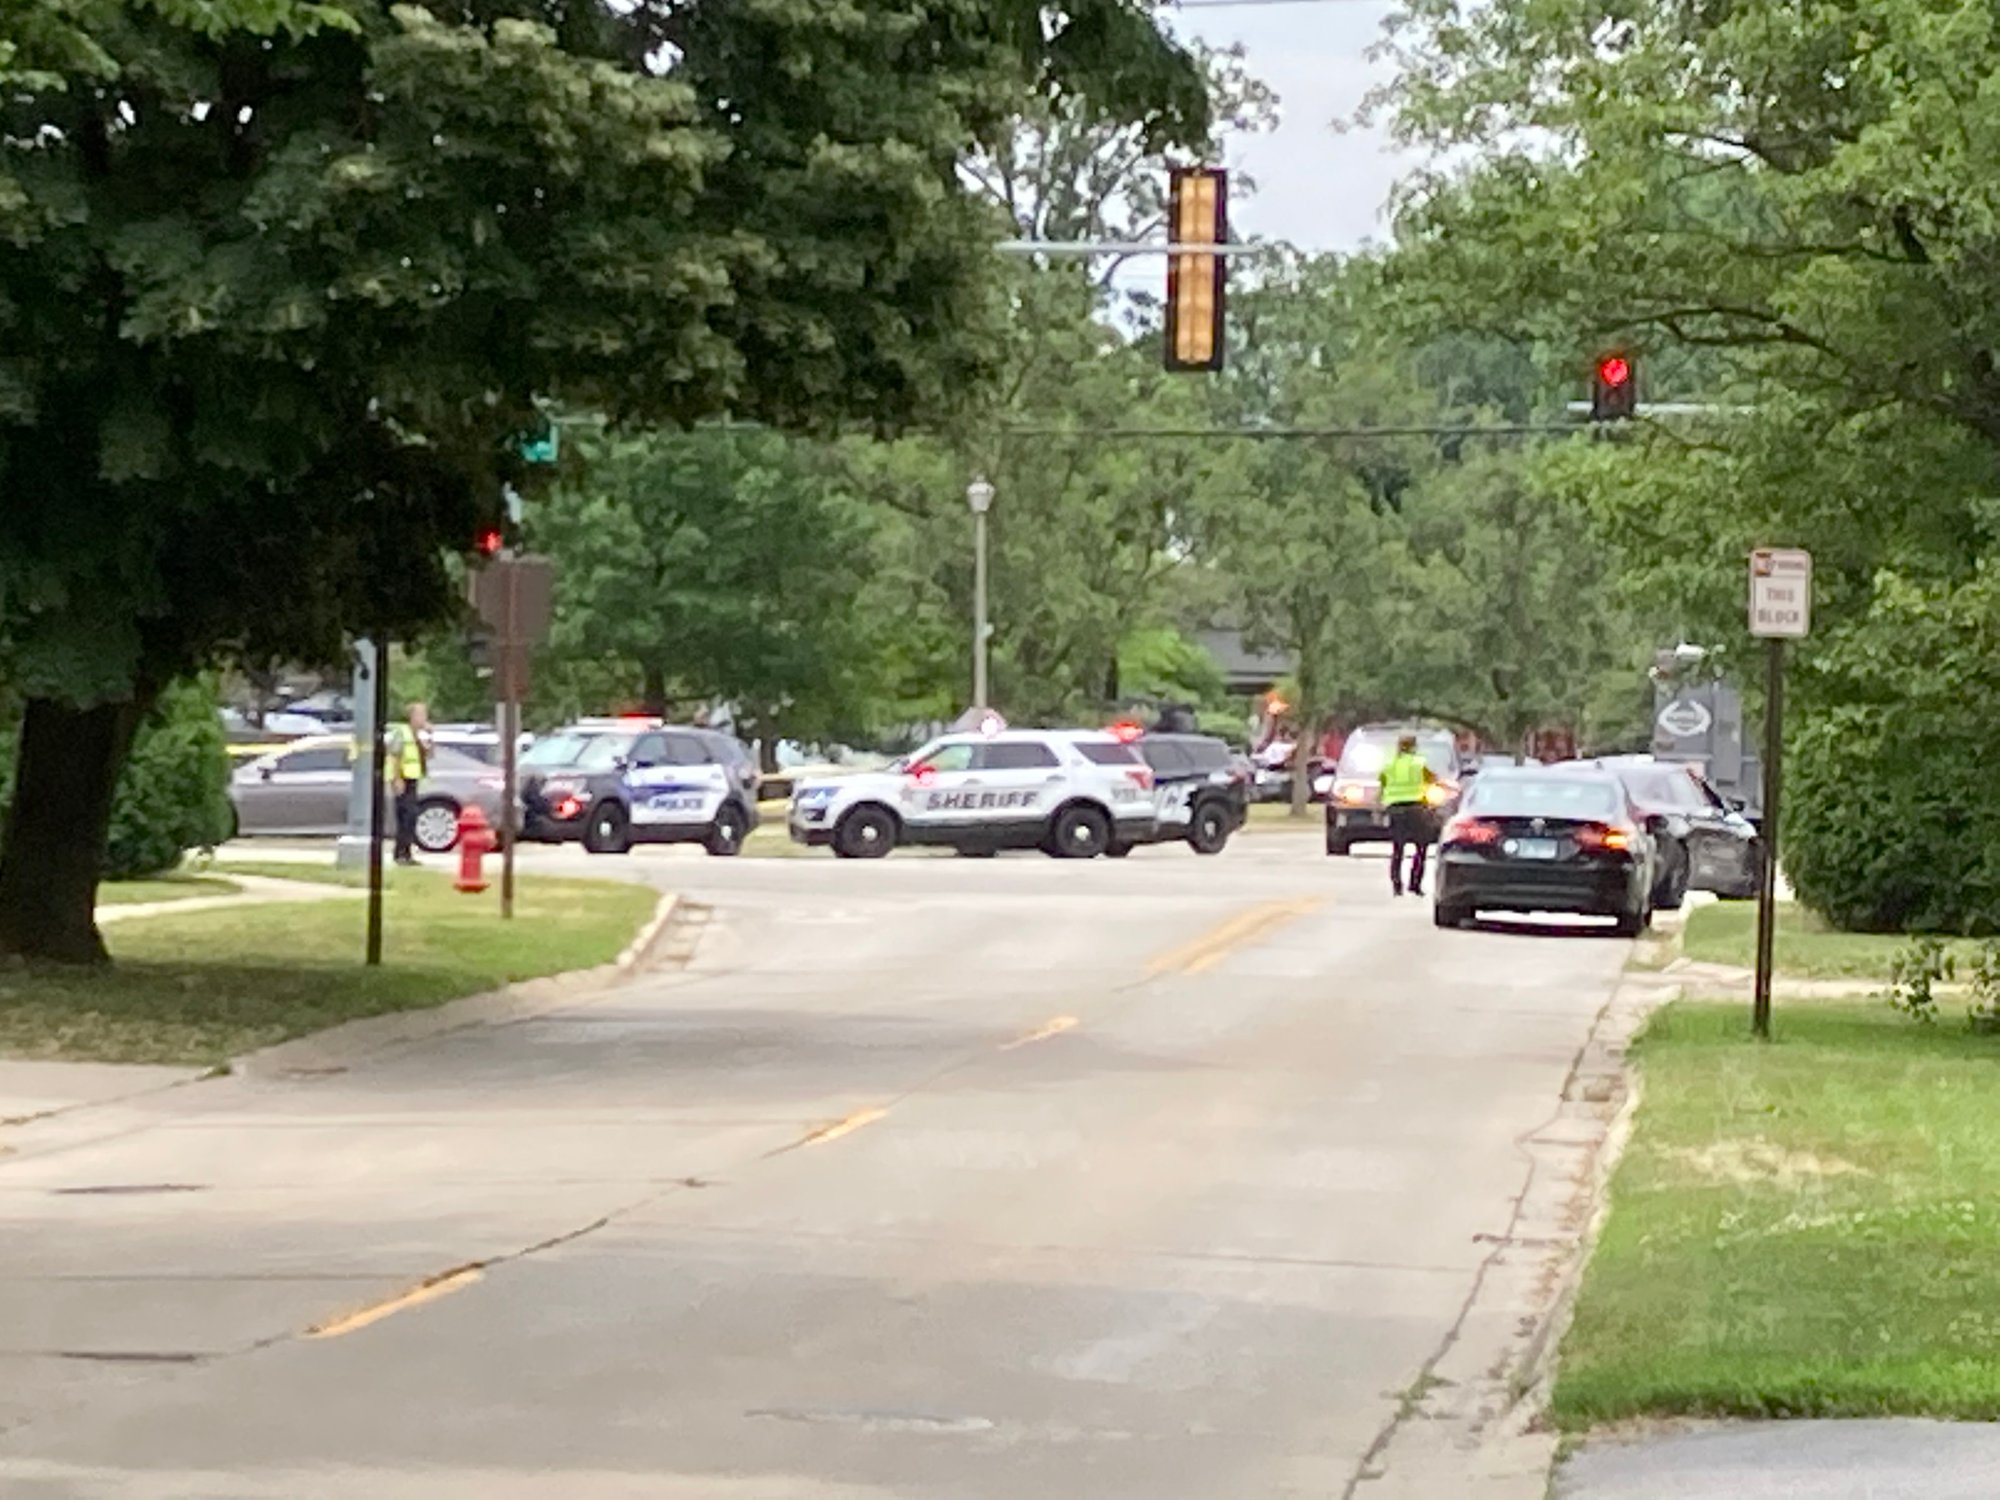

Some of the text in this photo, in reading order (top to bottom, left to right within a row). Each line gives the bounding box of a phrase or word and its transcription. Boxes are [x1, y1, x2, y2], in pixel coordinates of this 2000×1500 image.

[1766, 587, 1795, 603] THIS
[1758, 608, 1799, 624] BLOCK
[926, 791, 1040, 811] SHERIFF
